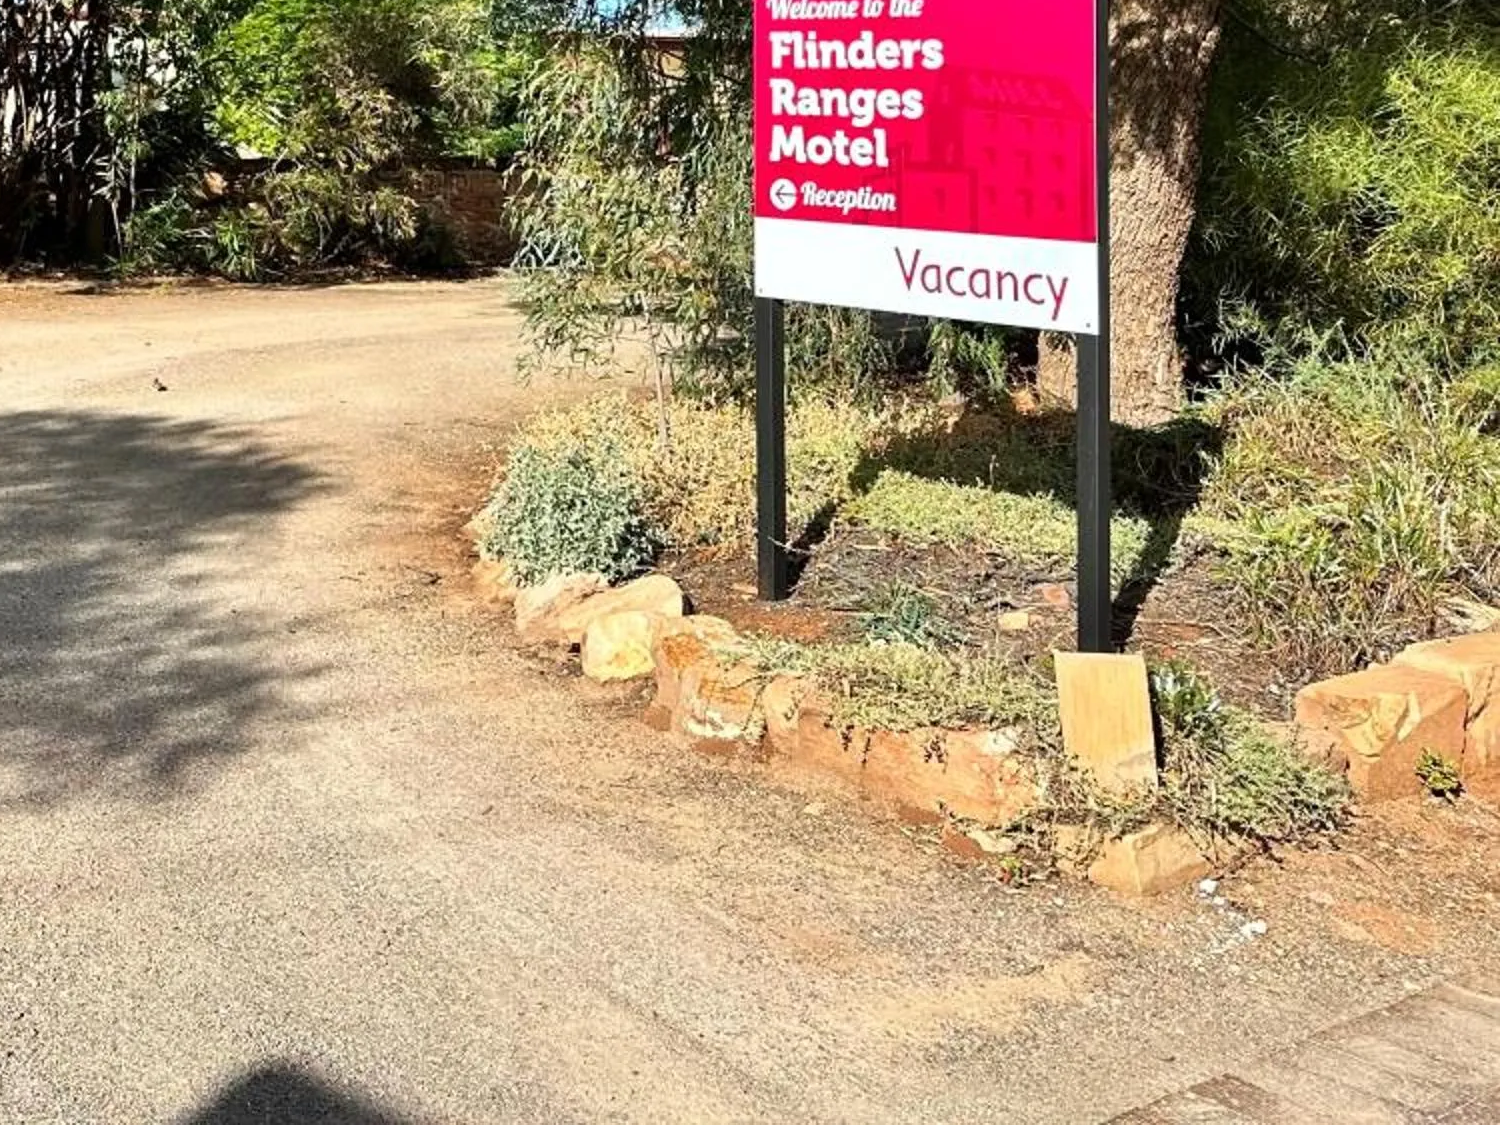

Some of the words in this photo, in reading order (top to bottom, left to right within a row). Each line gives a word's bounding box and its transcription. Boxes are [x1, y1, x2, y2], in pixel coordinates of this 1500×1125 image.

[769, 30, 945, 70] Flinders
[769, 78, 924, 127] Ranges
[769, 125, 889, 167] Motel
[800, 181, 897, 216] Reception
[894, 246, 1069, 321] Vacancy
